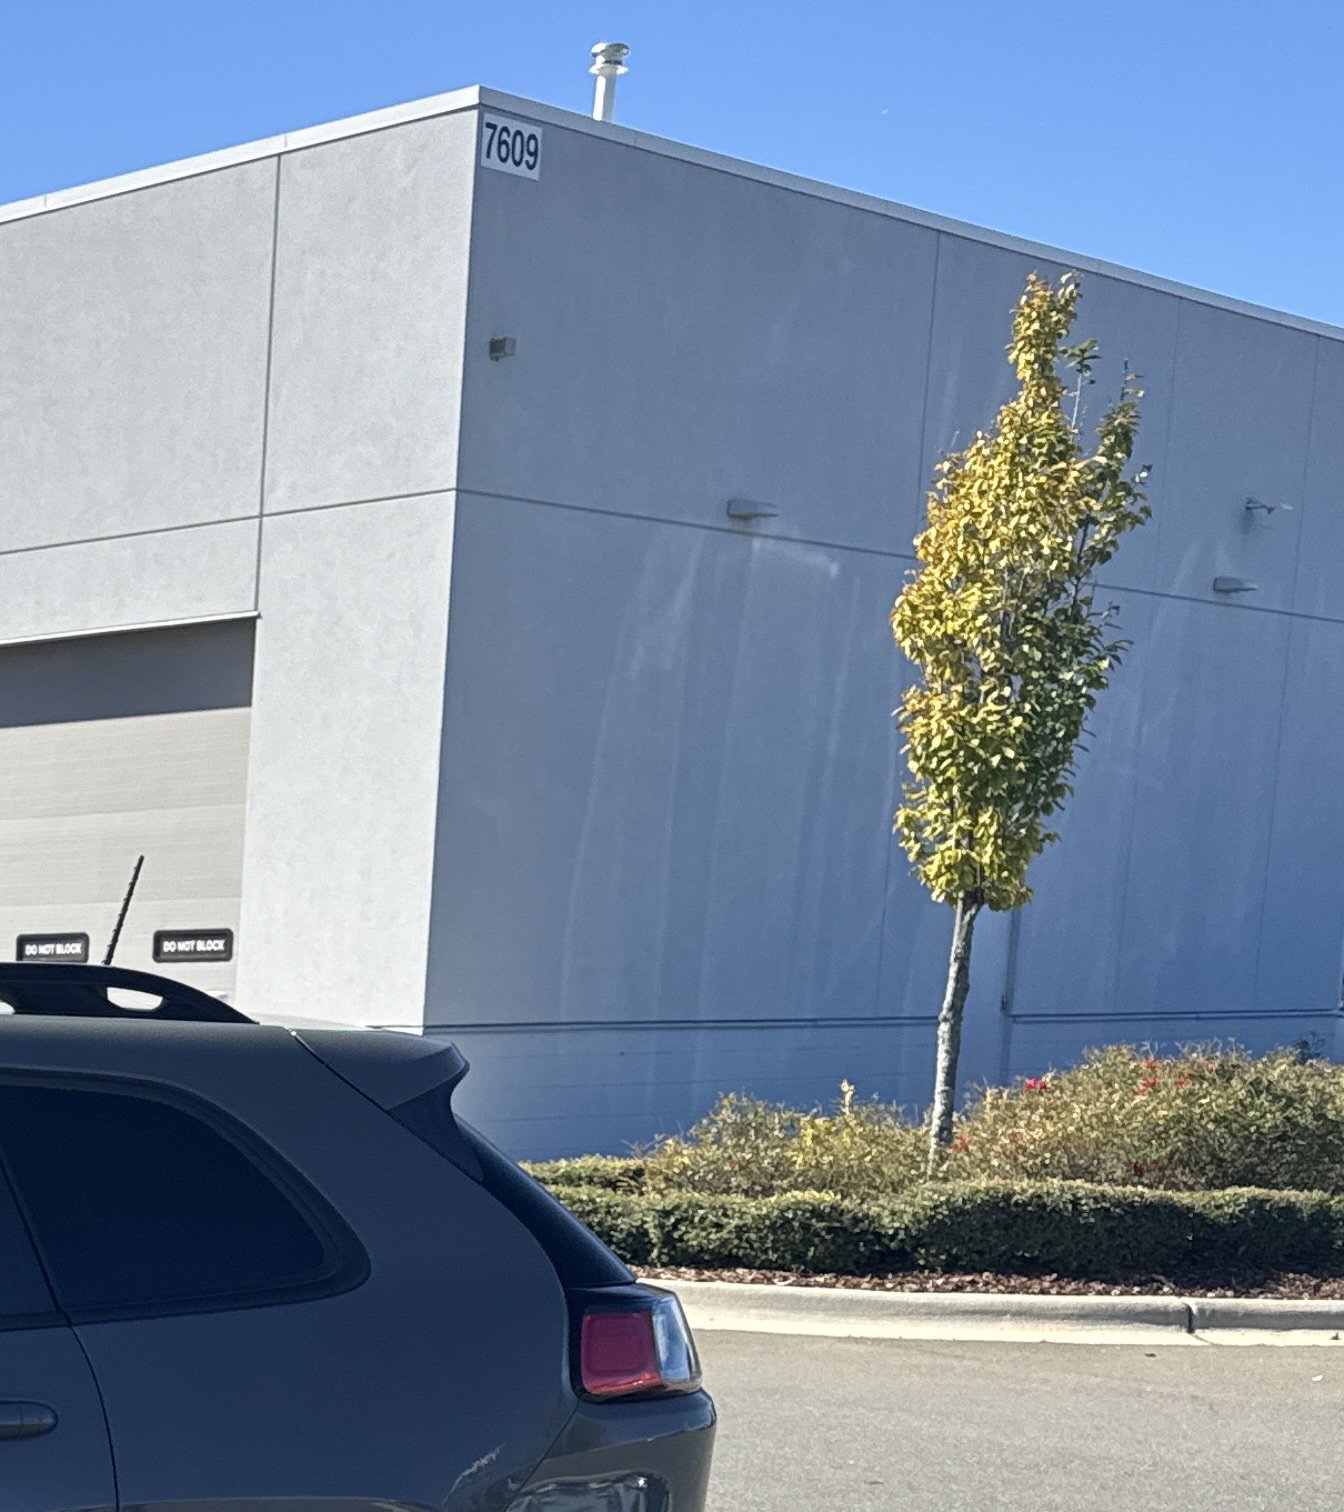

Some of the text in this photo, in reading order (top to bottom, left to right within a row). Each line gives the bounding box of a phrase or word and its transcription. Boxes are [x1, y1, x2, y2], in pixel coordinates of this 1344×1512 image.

[485, 122, 539, 171] 7609
[25, 942, 82, 956] DO NOT BLOCK
[162, 939, 225, 953] DO NOT BLOCK
